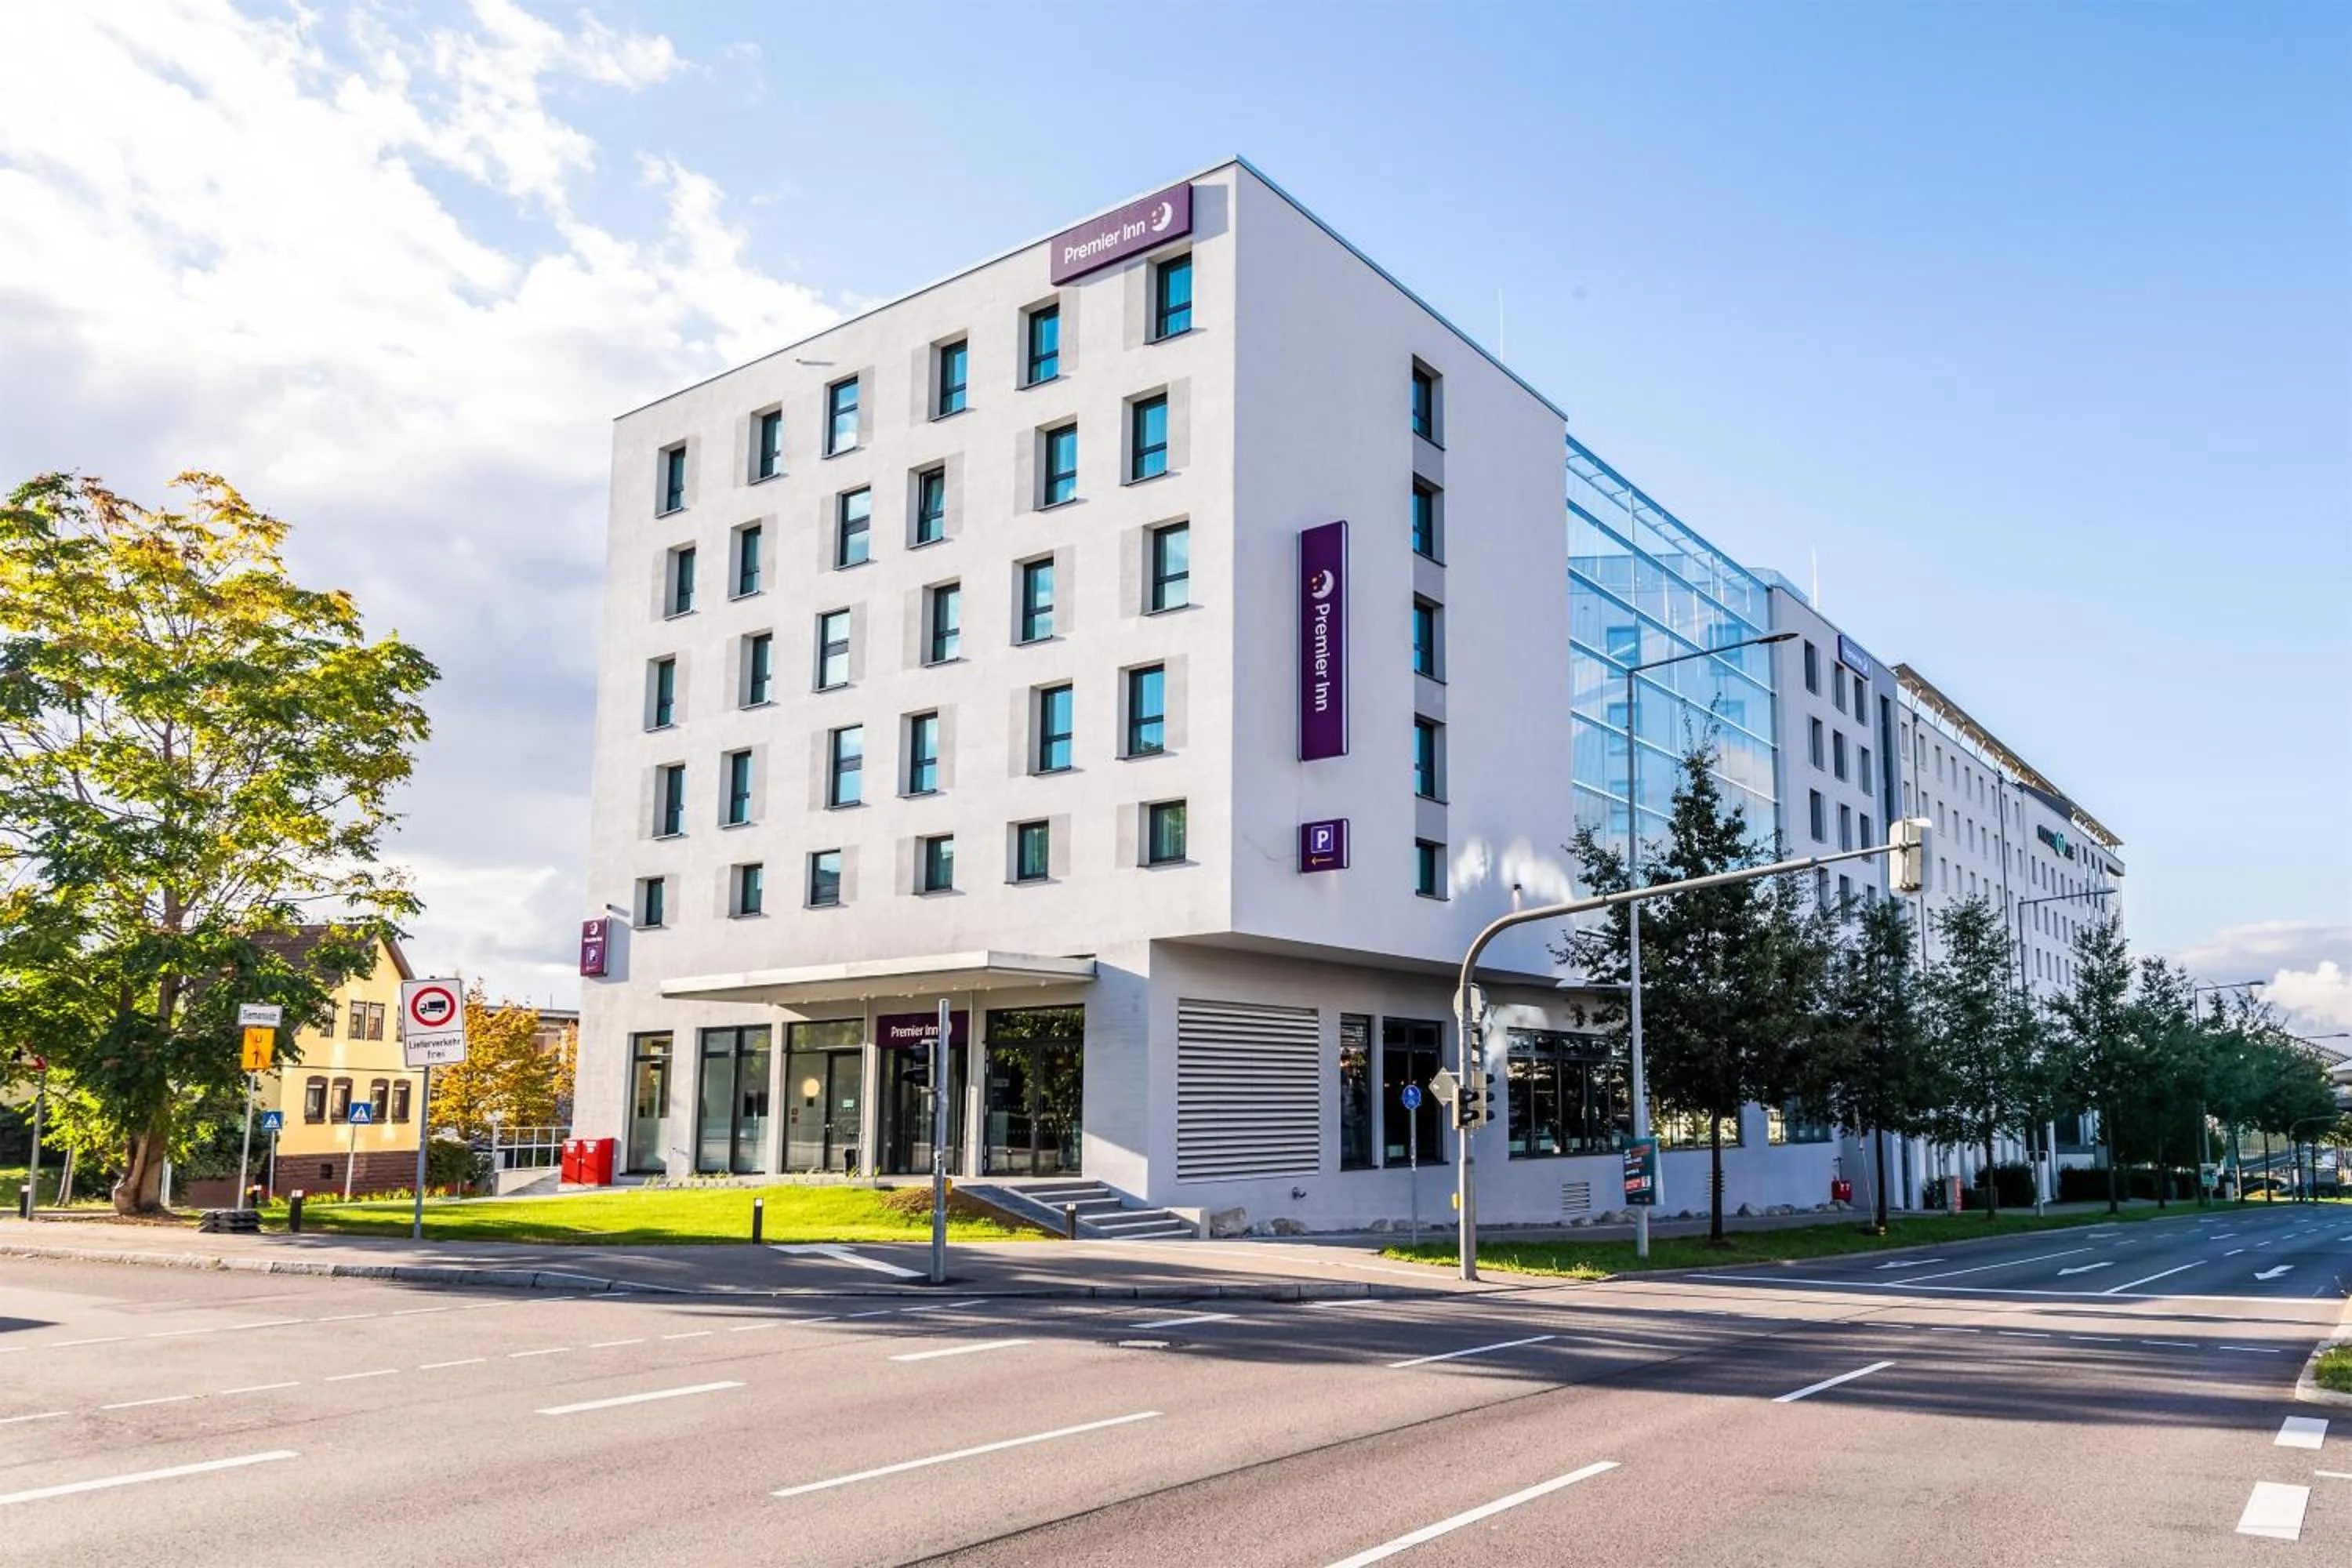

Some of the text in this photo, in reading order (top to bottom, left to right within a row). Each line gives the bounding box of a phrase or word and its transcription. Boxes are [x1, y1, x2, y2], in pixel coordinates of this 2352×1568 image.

[1064, 220, 1145, 264] Premier Inn
[1315, 603, 1330, 712] Premier Inn
[1317, 830, 1329, 849] P
[891, 1024, 938, 1038] Premier Inn
[408, 1037, 460, 1050] Lieferverkehr
